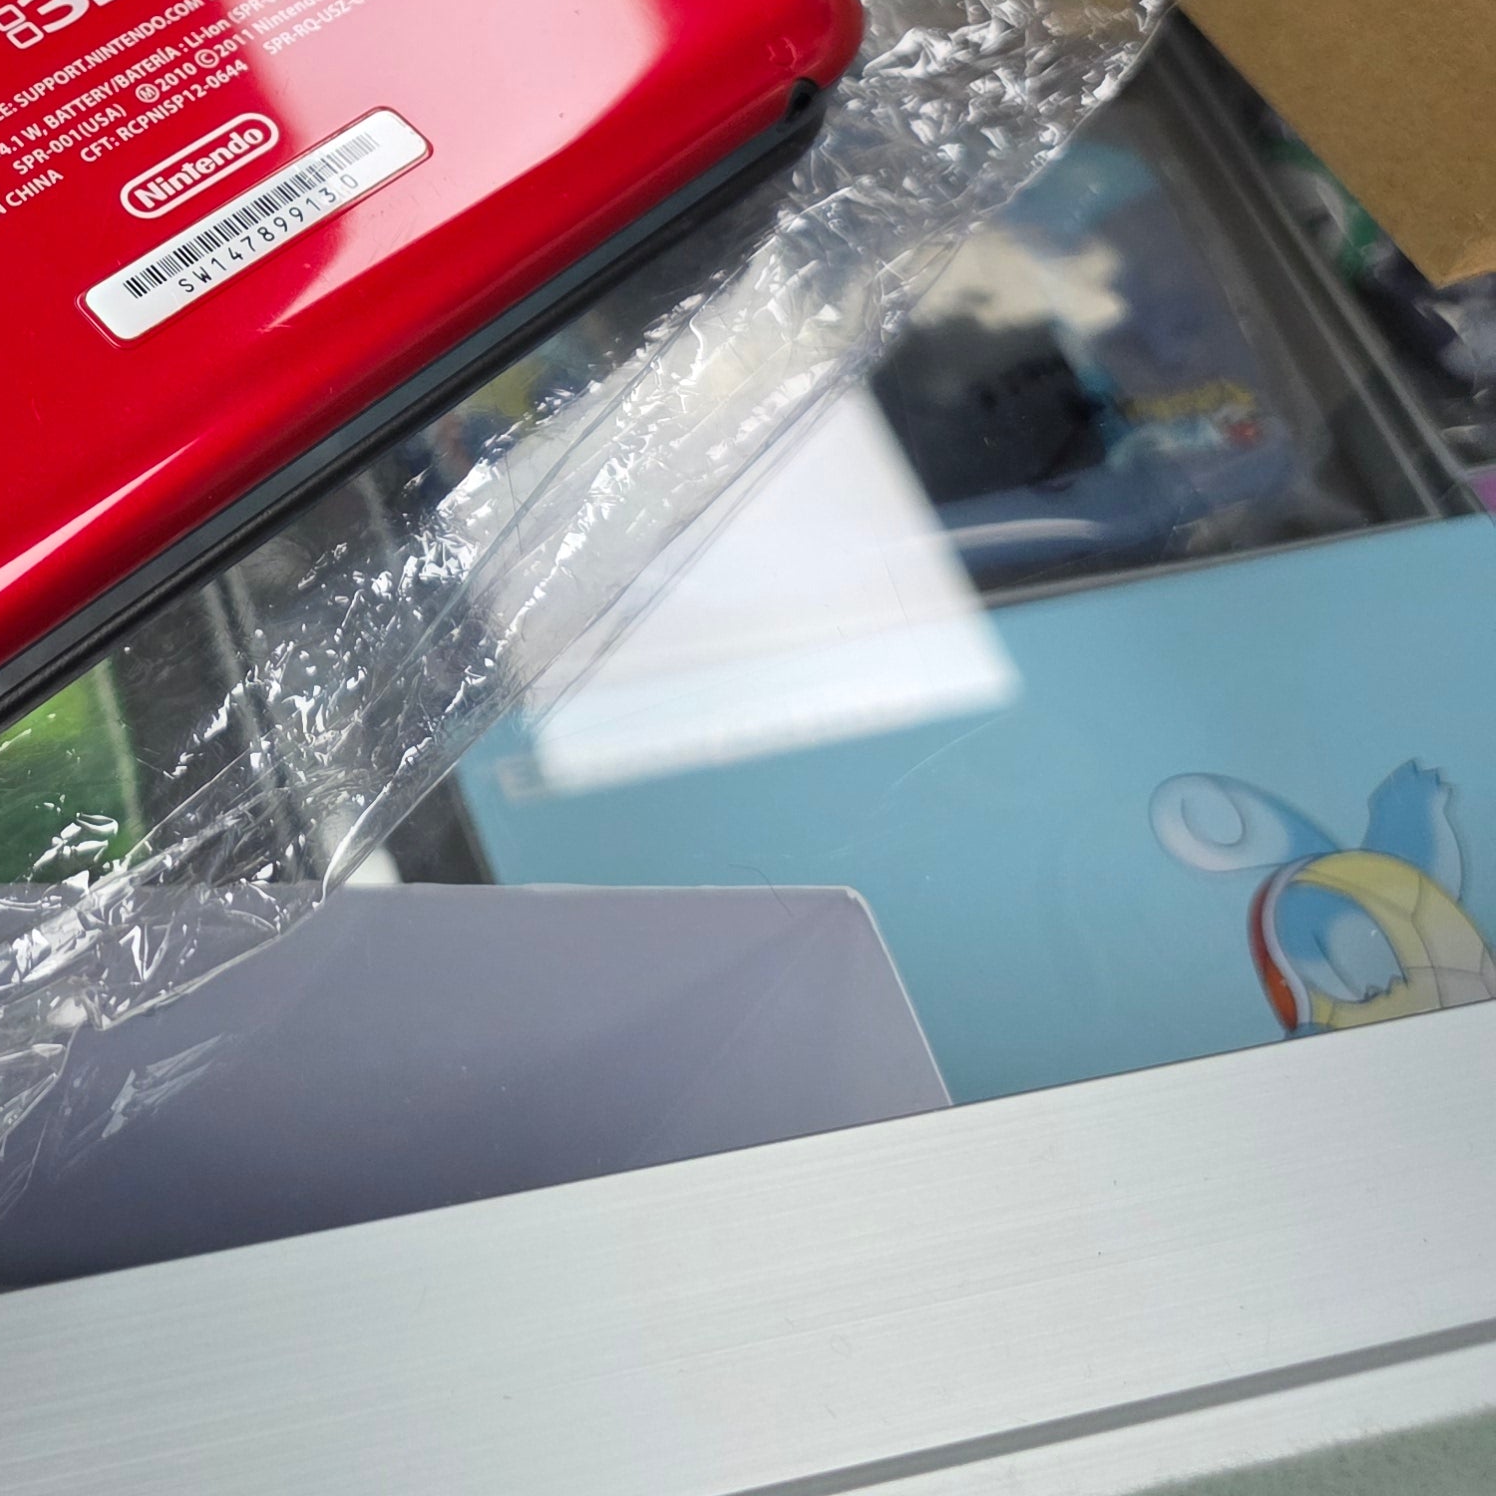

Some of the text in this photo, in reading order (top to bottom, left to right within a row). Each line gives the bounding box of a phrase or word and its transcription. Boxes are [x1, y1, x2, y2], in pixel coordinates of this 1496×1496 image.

[12, 103, 127, 175] SPR-001(USA)
[20, 123, 48, 141] W,
[80, 59, 249, 162] CFT: RCPNISP12-0644
[5, 169, 64, 207] CHINA
[133, 128, 265, 210] Nintendo
